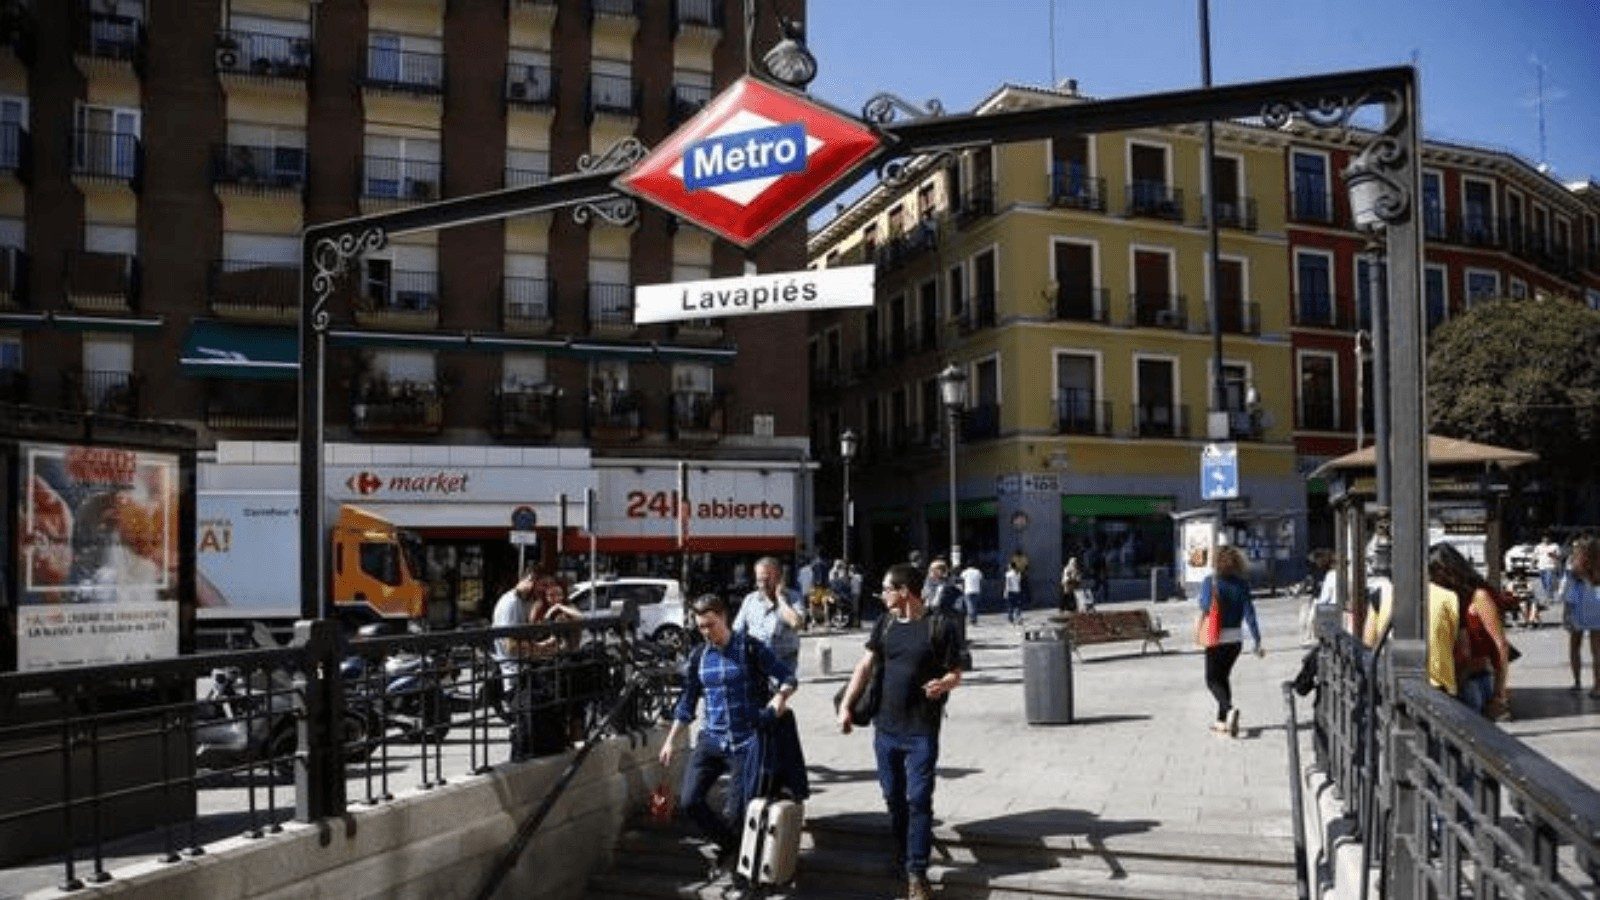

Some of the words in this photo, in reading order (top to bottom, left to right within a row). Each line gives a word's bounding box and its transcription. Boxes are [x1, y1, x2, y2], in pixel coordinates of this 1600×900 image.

[693, 138, 797, 180] Metro
[681, 279, 819, 311] Lavapiés
[388, 472, 469, 494] market
[626, 489, 692, 519] 24h
[697, 497, 784, 519] abierto
